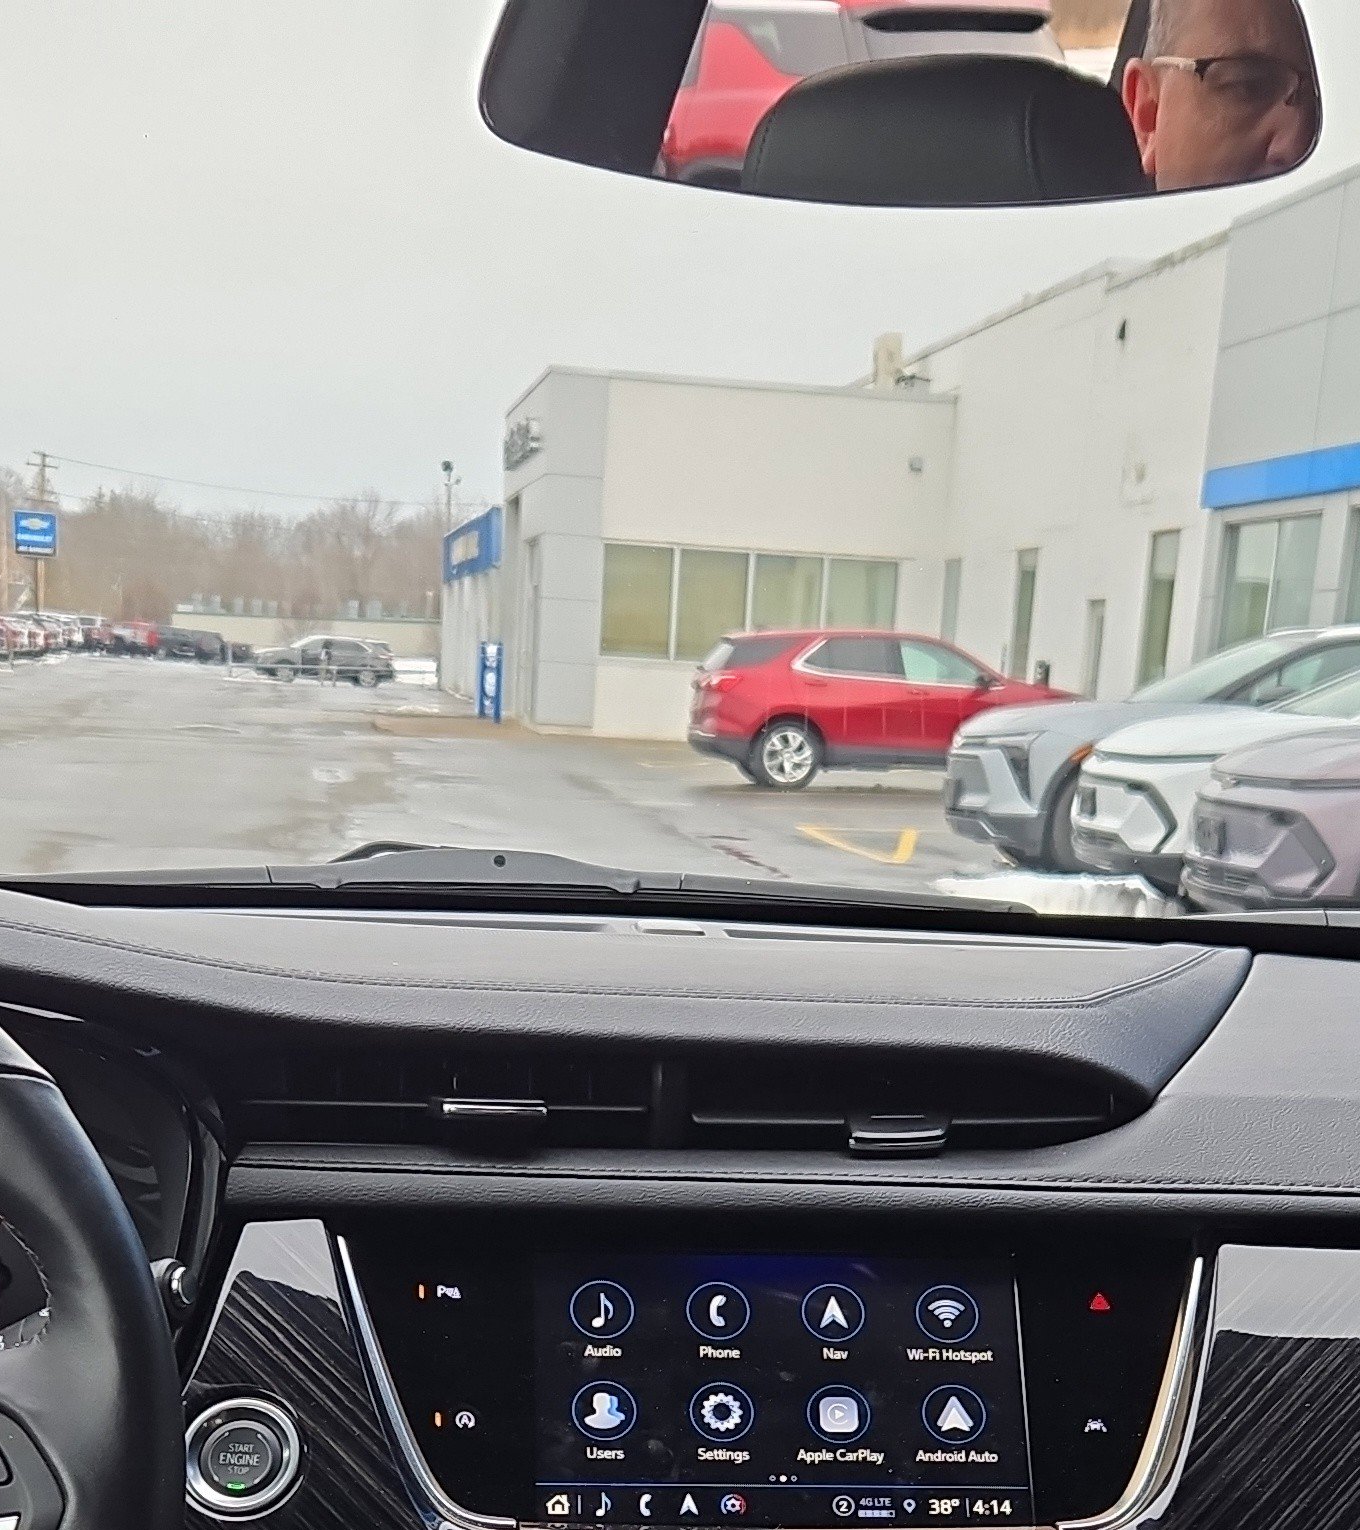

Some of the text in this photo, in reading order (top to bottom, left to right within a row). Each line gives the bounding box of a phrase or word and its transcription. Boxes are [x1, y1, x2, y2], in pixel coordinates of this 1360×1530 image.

[583, 1345, 622, 1358] Audio
[699, 1346, 741, 1359] Phone
[822, 1348, 849, 1360] Nav
[906, 1349, 994, 1364] Wi-Fi Hotspot
[228, 1443, 254, 1452] START
[586, 1447, 625, 1460] Users
[219, 1452, 260, 1466] ENGINE
[697, 1448, 751, 1464] Settings
[796, 1449, 885, 1464] Apple CarPlay
[916, 1450, 999, 1463] Android Auto
[227, 1466, 249, 1474] STOP
[859, 1497, 892, 1507] 4G LTE
[972, 1498, 1013, 1516] 4:14
